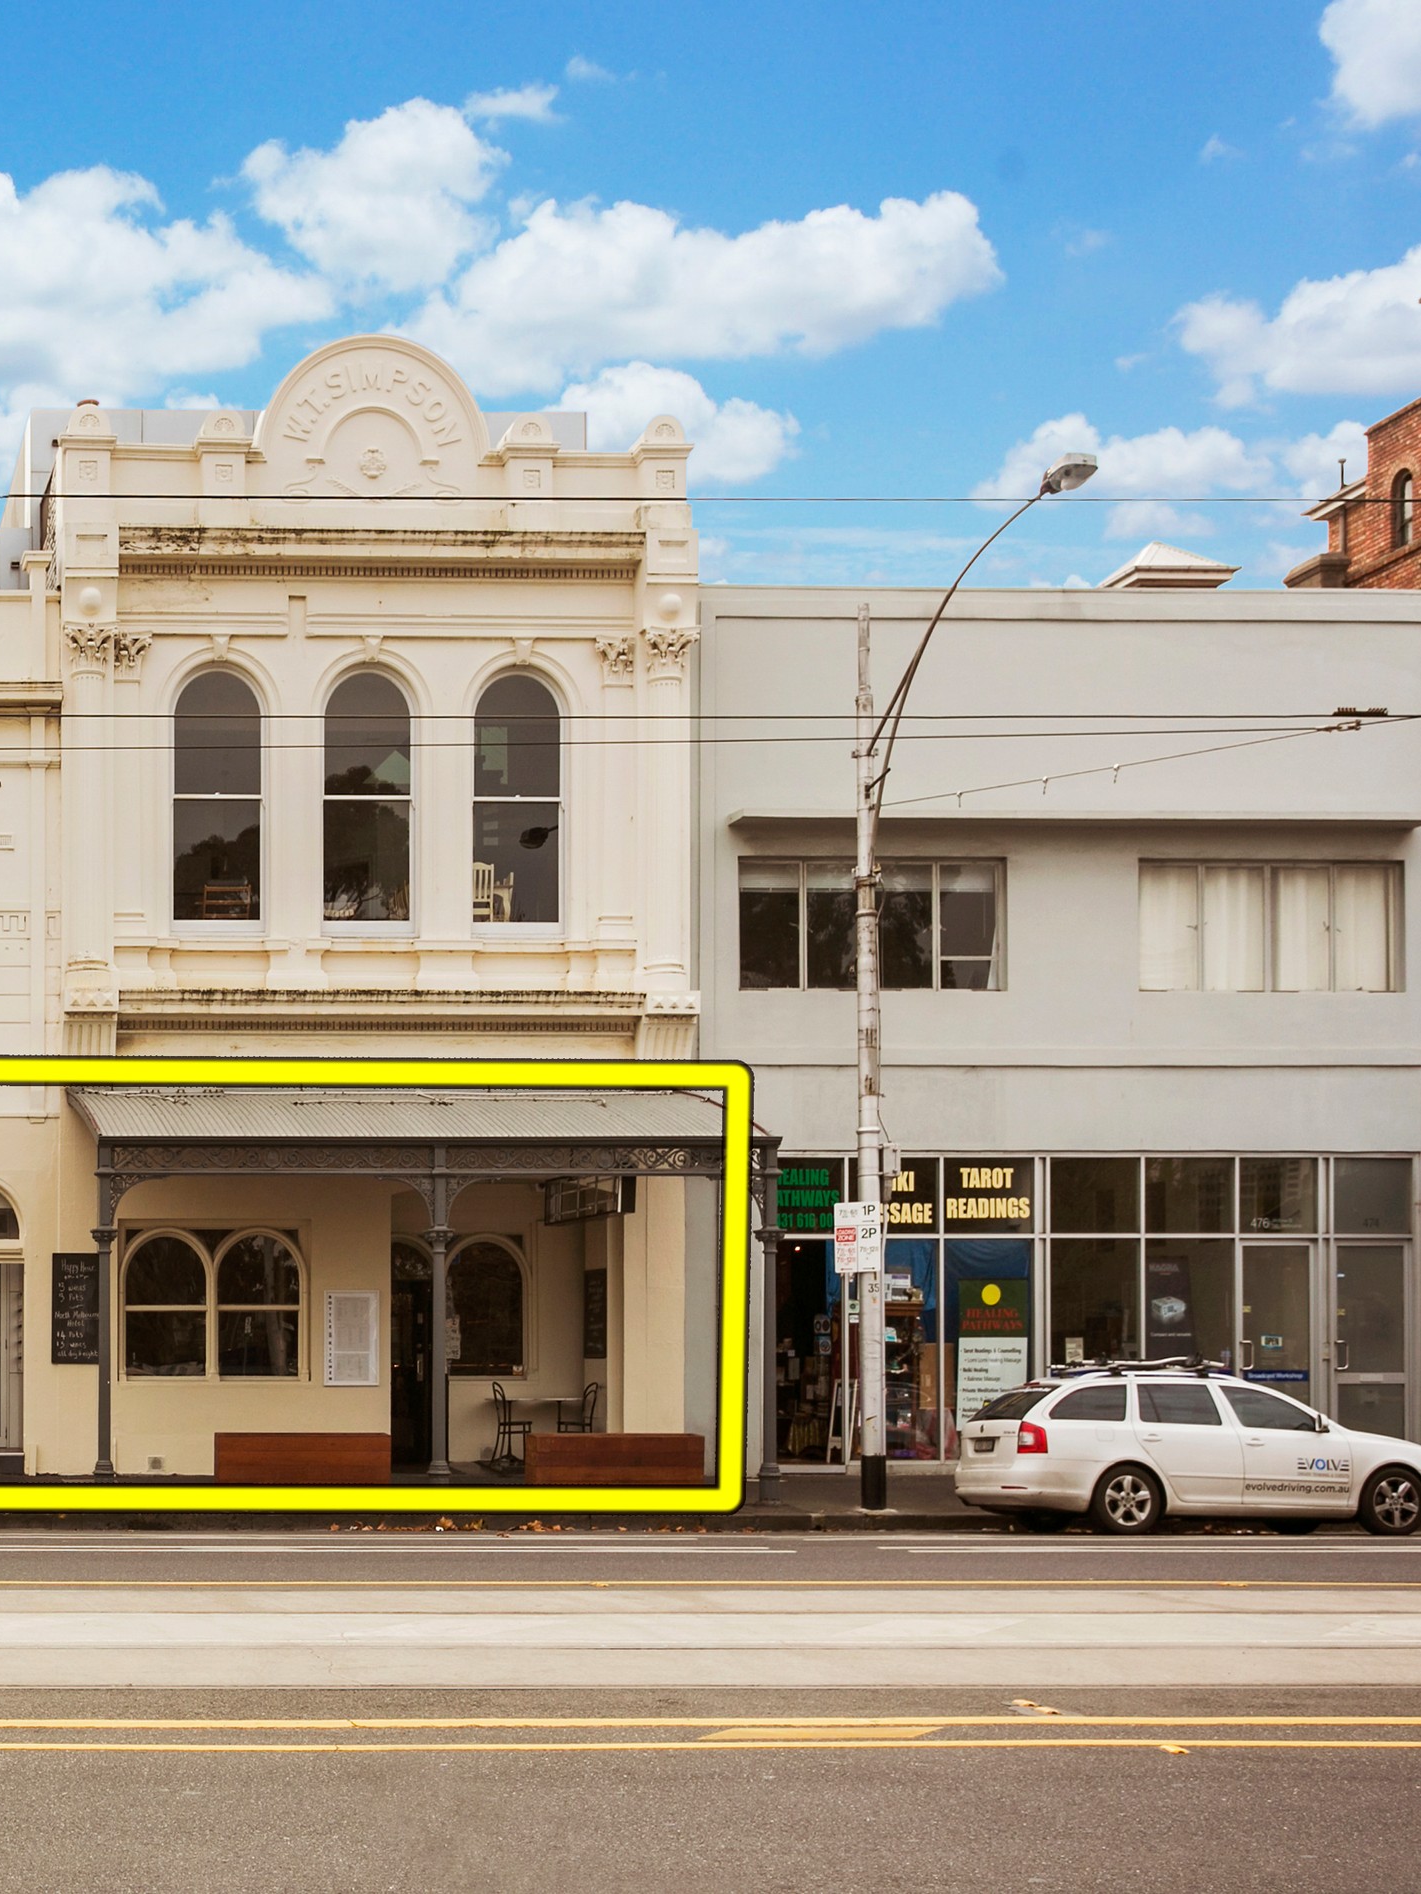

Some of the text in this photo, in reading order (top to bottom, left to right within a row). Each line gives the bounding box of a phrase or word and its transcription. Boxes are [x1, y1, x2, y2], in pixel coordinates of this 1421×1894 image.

[326, 363, 462, 447] SIMPSON
[960, 1168, 1014, 1188] TAROT
[777, 1190, 840, 1207] ATHWAYS
[862, 1204, 876, 1216] 1P
[946, 1198, 1030, 1218] READINGS
[820, 1213, 834, 1228] 00
[1250, 1218, 1270, 1228] 476
[861, 1228, 877, 1239] 2P
[868, 1284, 880, 1294] 35
[966, 1308, 1018, 1318] HEALING
[961, 1320, 1024, 1330] PATHWAYS
[1297, 1458, 1349, 1472] EVOLVE
[1245, 1482, 1350, 1494] evolvedriving.com.au
